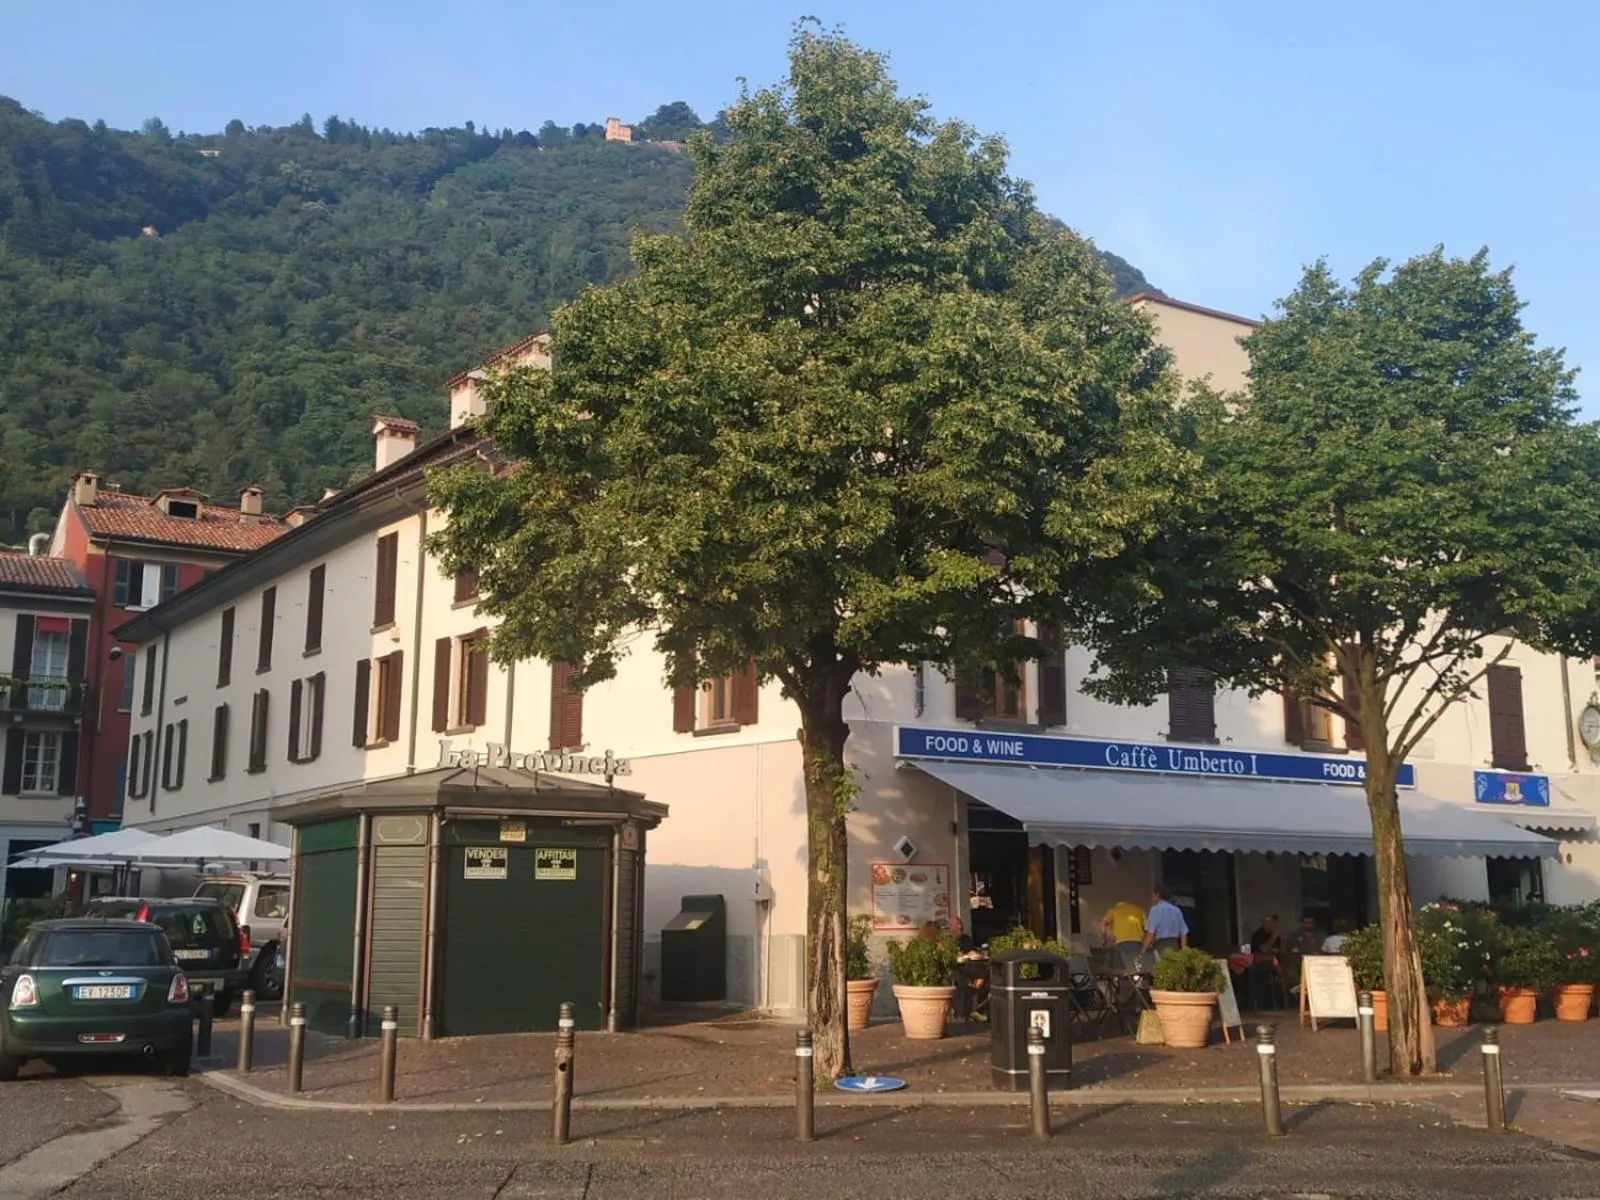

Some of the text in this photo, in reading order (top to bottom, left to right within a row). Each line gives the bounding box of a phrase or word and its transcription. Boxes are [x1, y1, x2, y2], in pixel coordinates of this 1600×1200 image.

[438, 739, 632, 776] La Provincia
[925, 735, 1024, 756] FOOD & WINE
[1105, 744, 1258, 775] Caffè Umberto I
[1323, 763, 1367, 779] FOOD &
